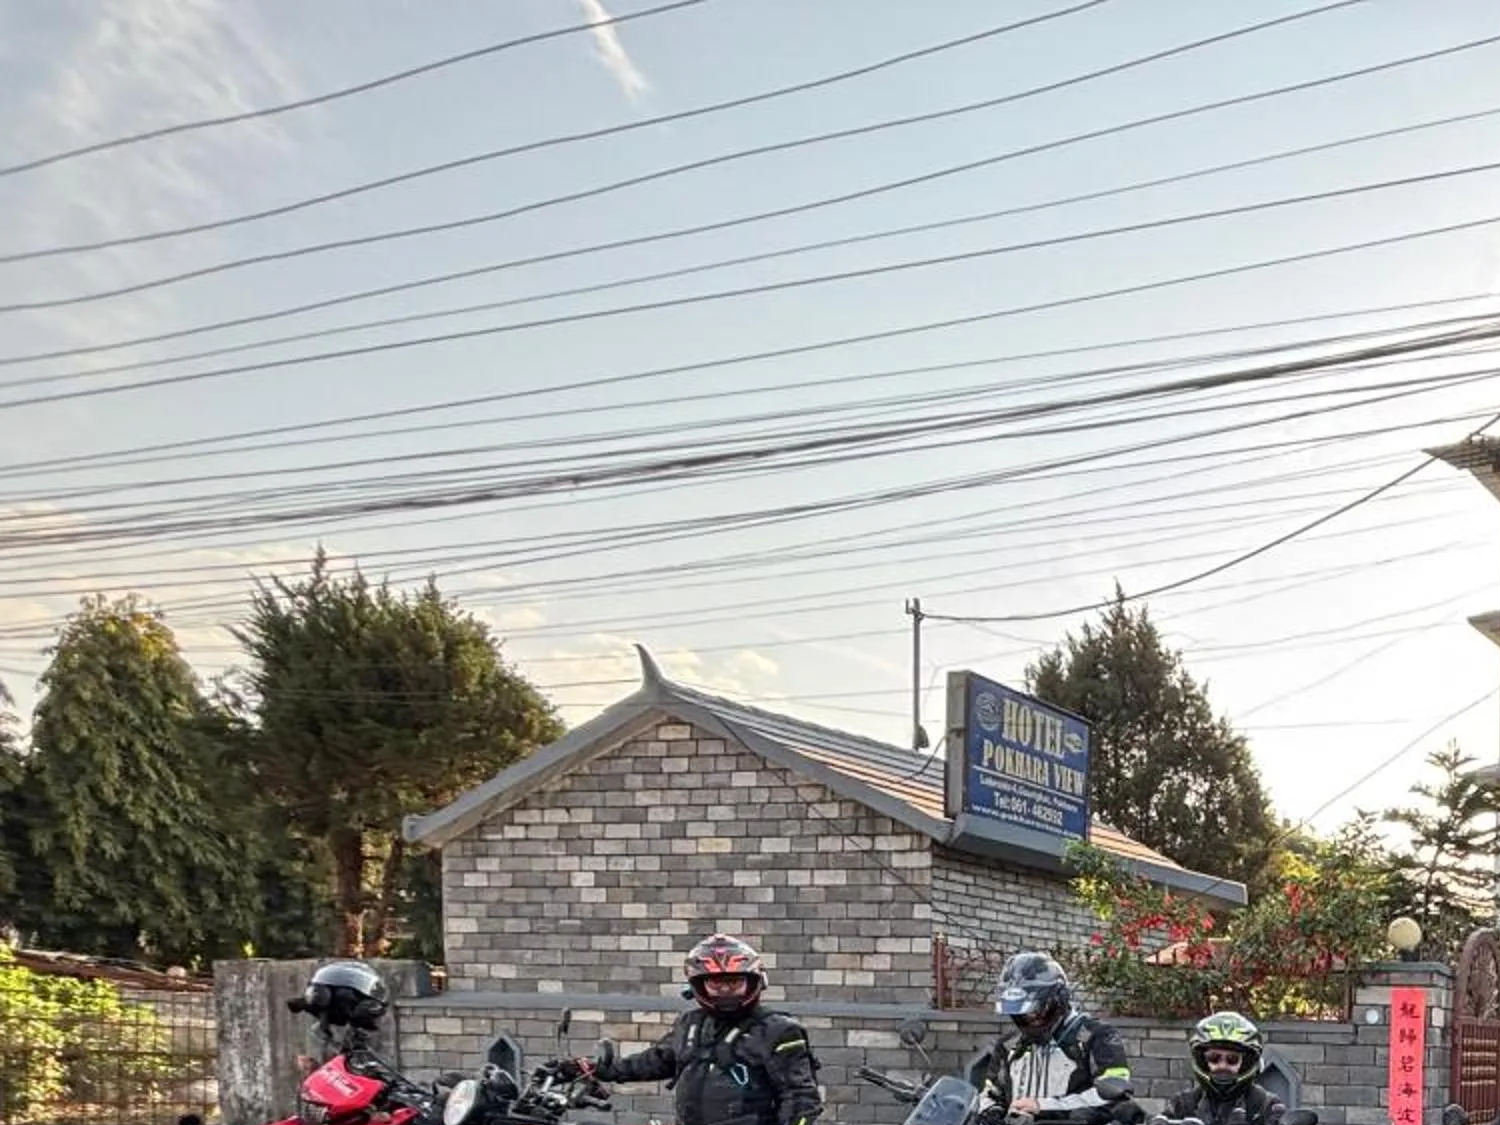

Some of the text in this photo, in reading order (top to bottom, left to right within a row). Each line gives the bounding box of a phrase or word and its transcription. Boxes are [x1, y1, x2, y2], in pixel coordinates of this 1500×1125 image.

[1002, 698, 1064, 758] HOTEL
[982, 739, 1049, 787] POKHARA
[1053, 763, 1085, 795] VIEW
